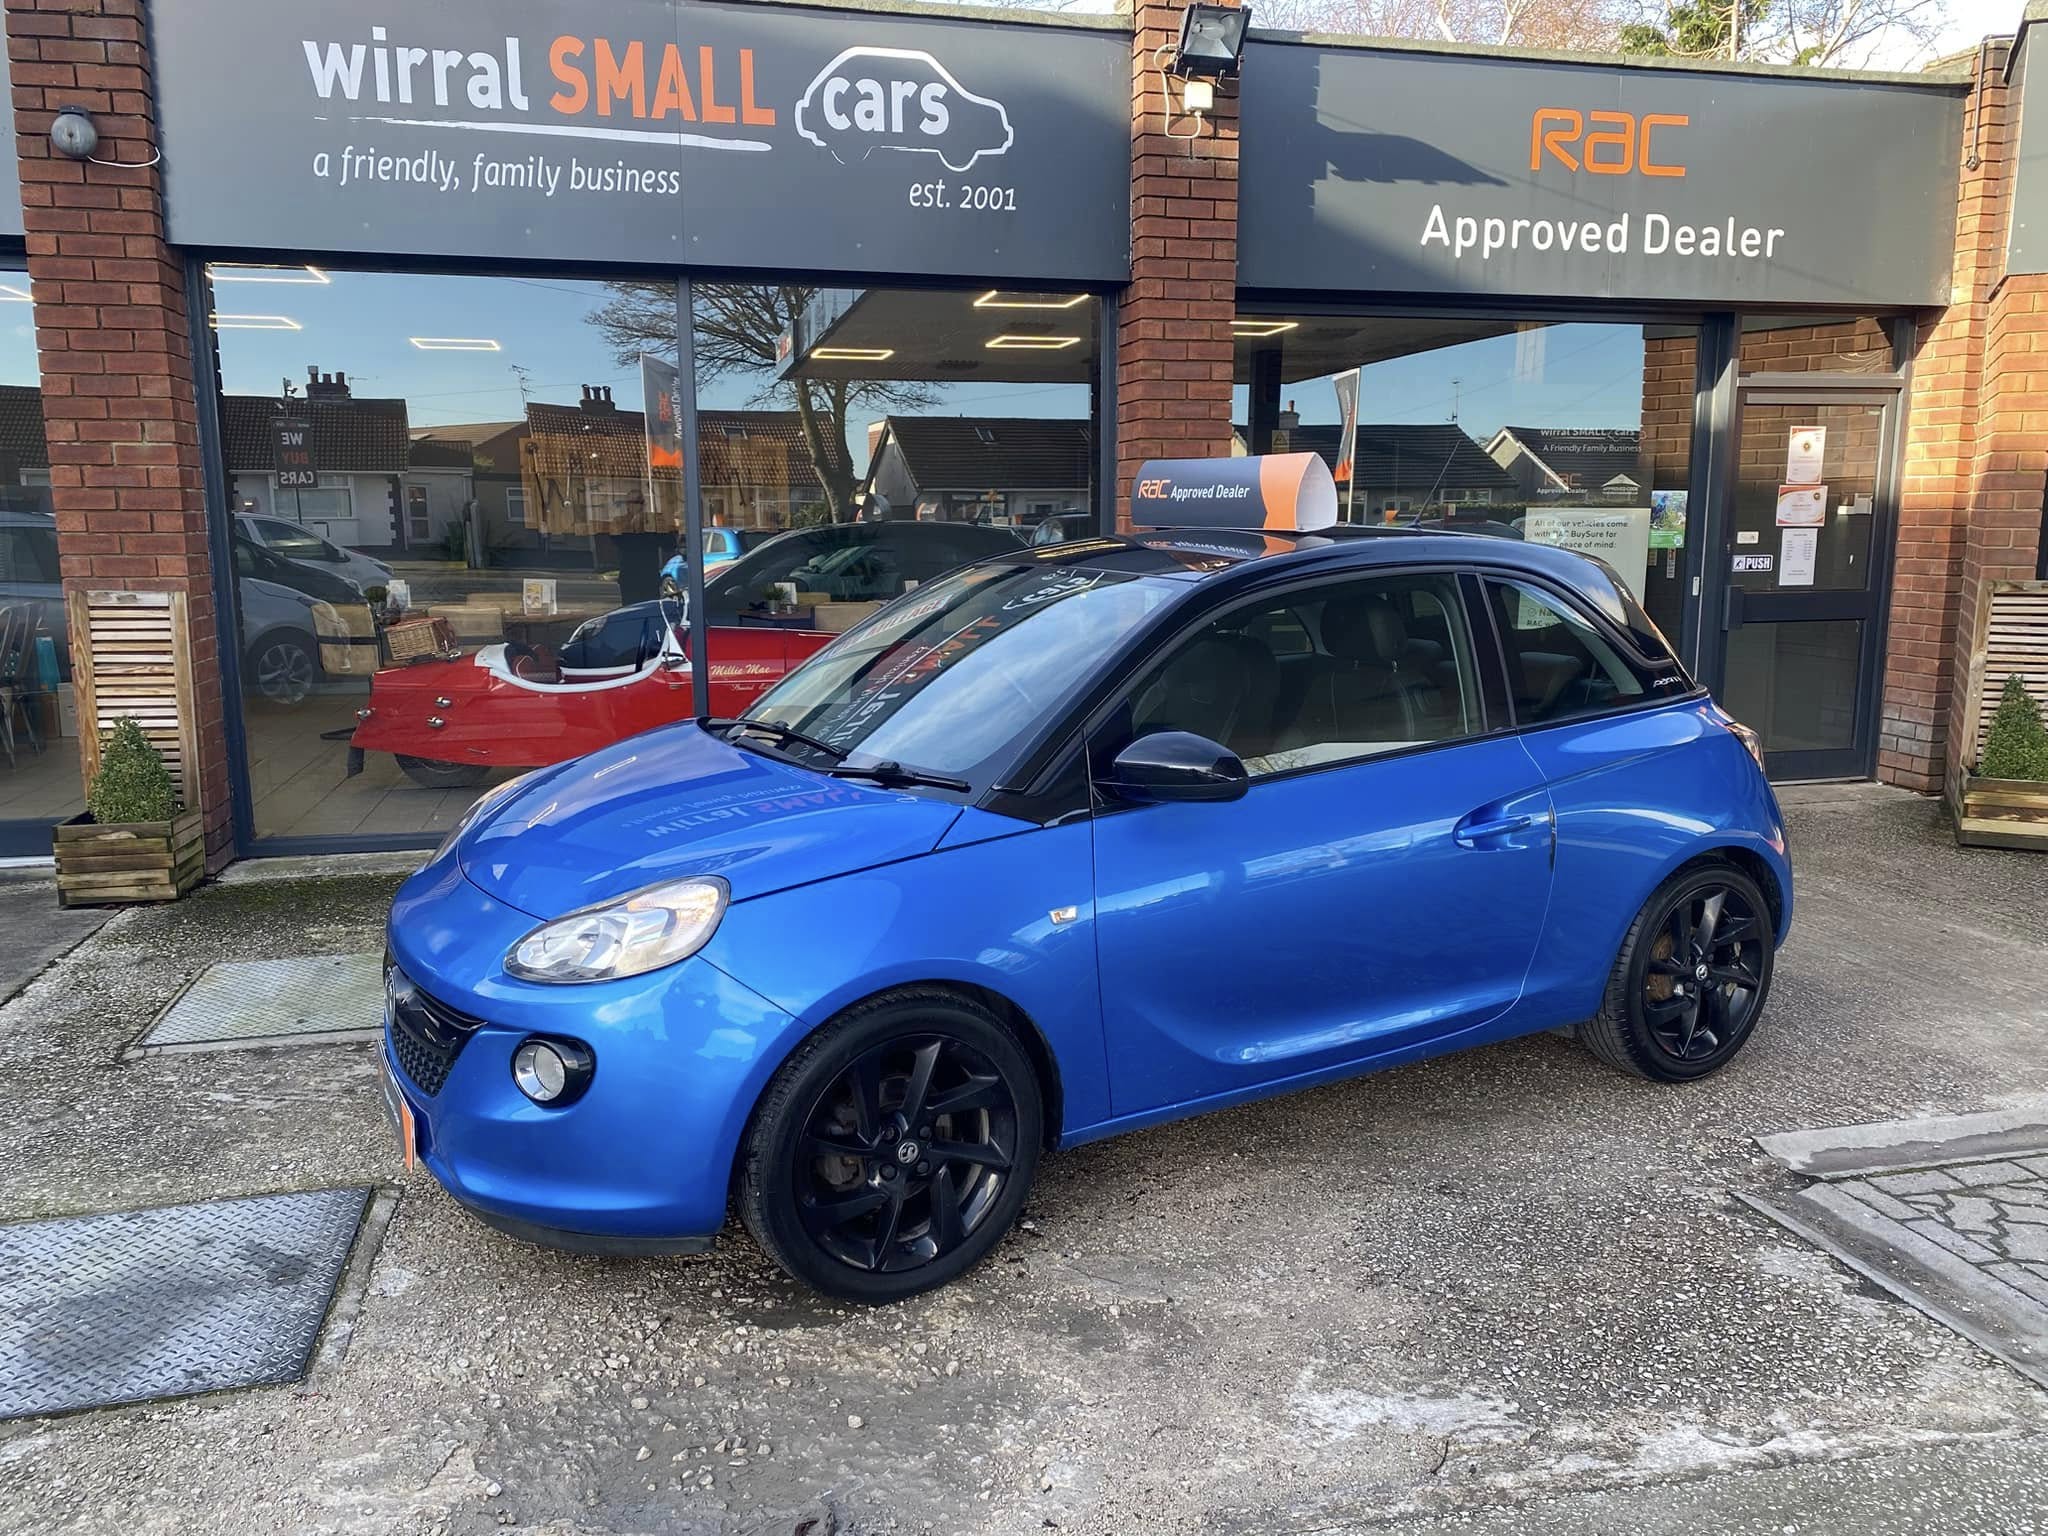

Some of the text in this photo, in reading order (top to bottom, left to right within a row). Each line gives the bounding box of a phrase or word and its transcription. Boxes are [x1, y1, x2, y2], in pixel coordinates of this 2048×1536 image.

[302, 25, 949, 136] wirral SMALL cars
[1529, 107, 1689, 178] RAC
[312, 145, 681, 197] a friendly, family business
[909, 180, 1017, 212] est. 2001
[1420, 203, 1785, 260] Approved Dealer
[1550, 444, 1581, 454] Friendly
[1583, 444, 1608, 454] Family
[1138, 479, 1250, 502] RAC Approved Dealer
[1571, 530, 1604, 539] BuySure
[1745, 557, 1771, 569] PUSH
